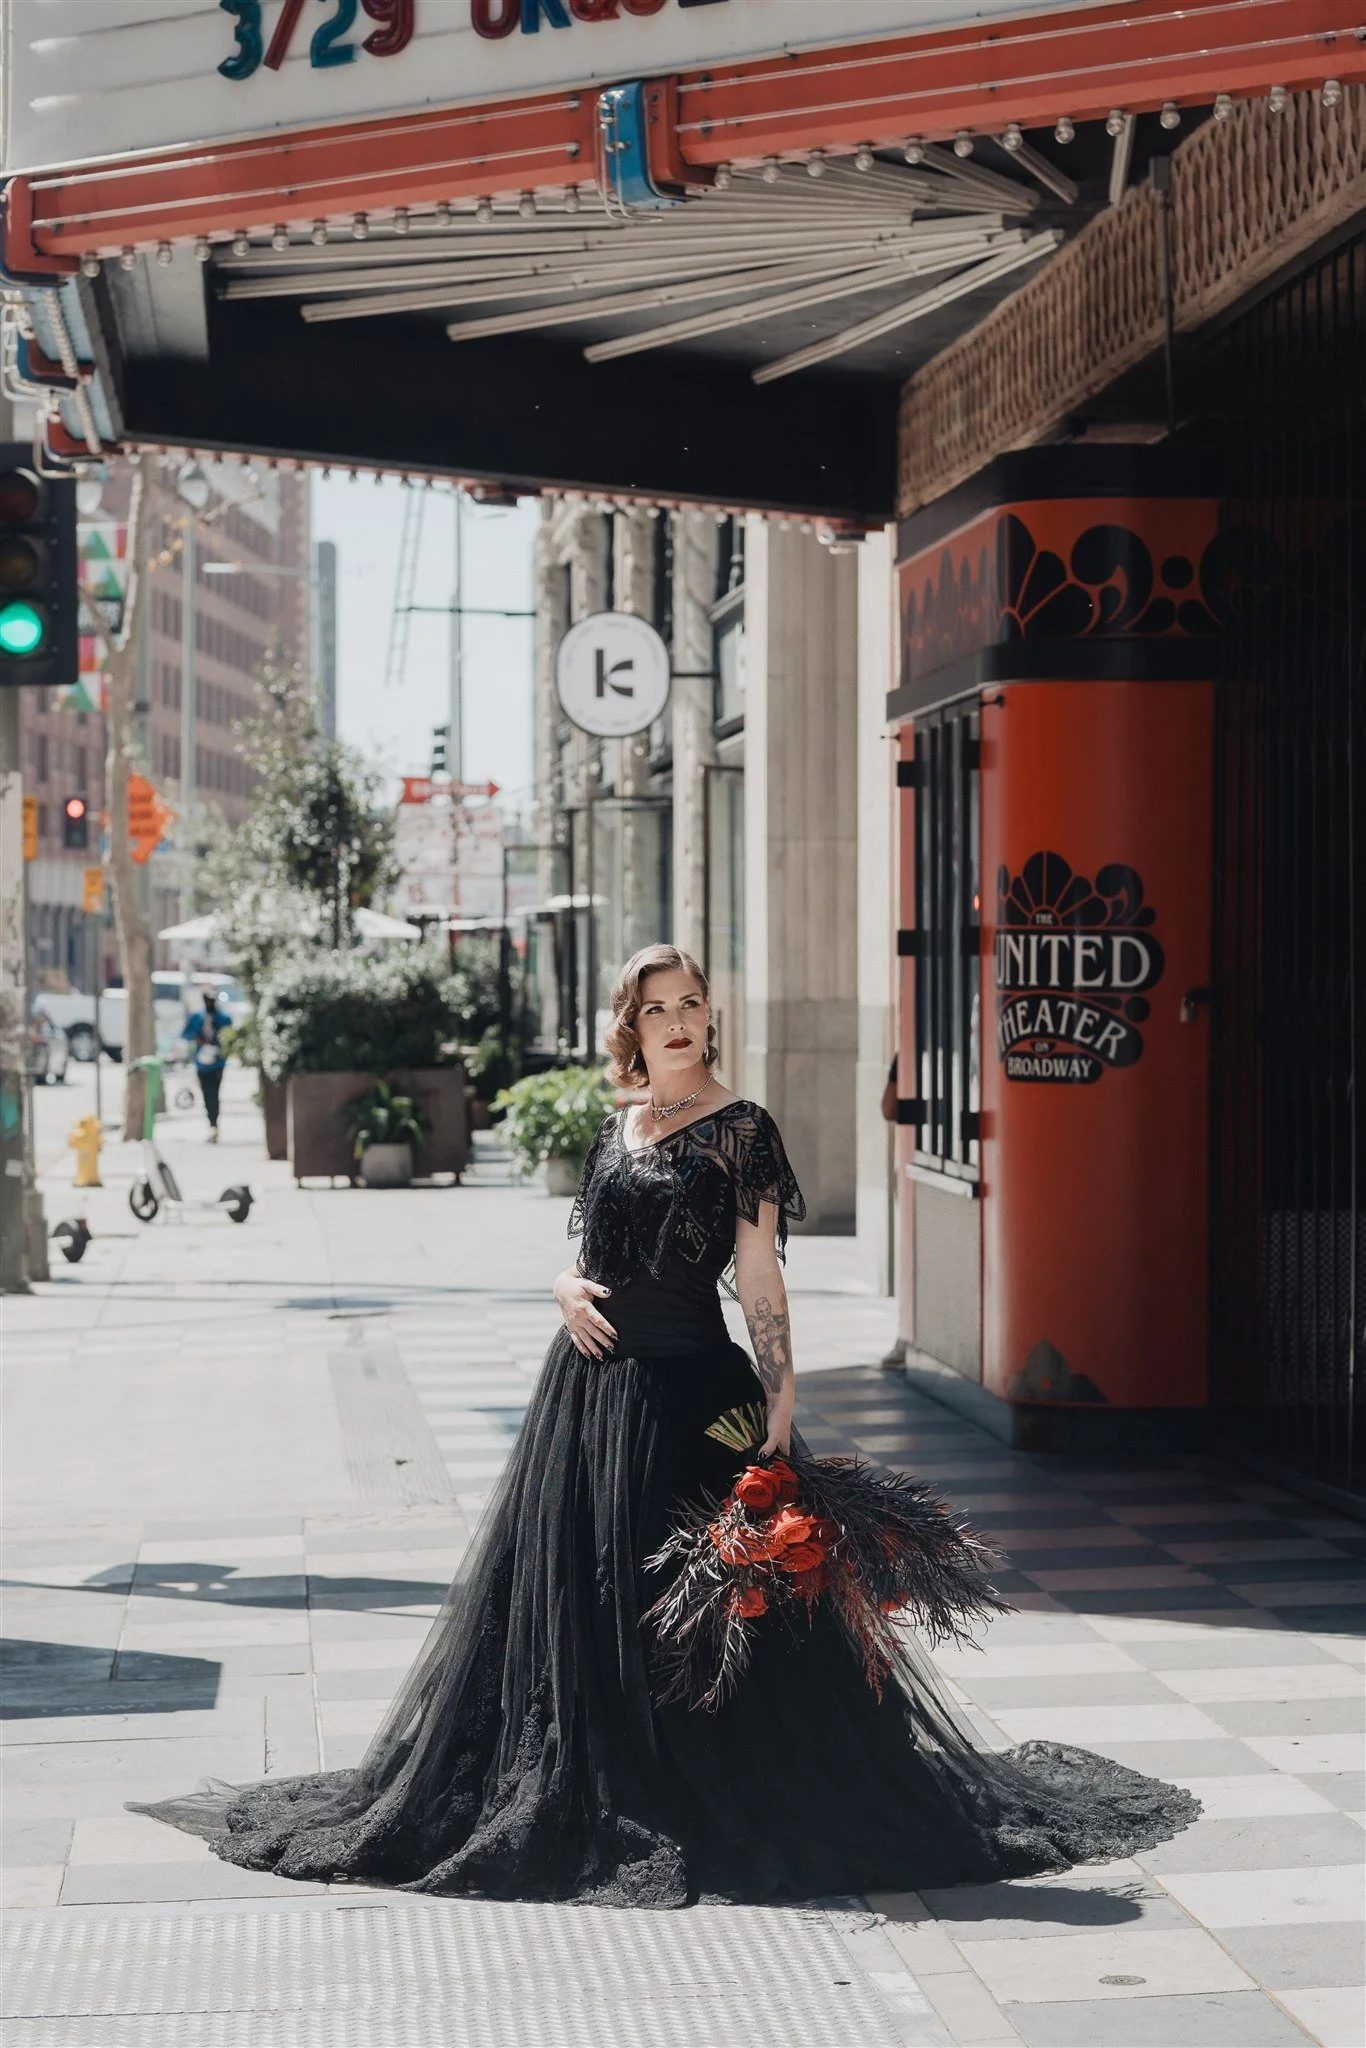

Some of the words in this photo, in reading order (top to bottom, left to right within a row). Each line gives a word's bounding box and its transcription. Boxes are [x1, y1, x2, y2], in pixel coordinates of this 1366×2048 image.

[217, 0, 415, 81] 3/29
[994, 934, 1151, 987] UNITED
[1007, 1056, 1093, 1079] BROADWAY
